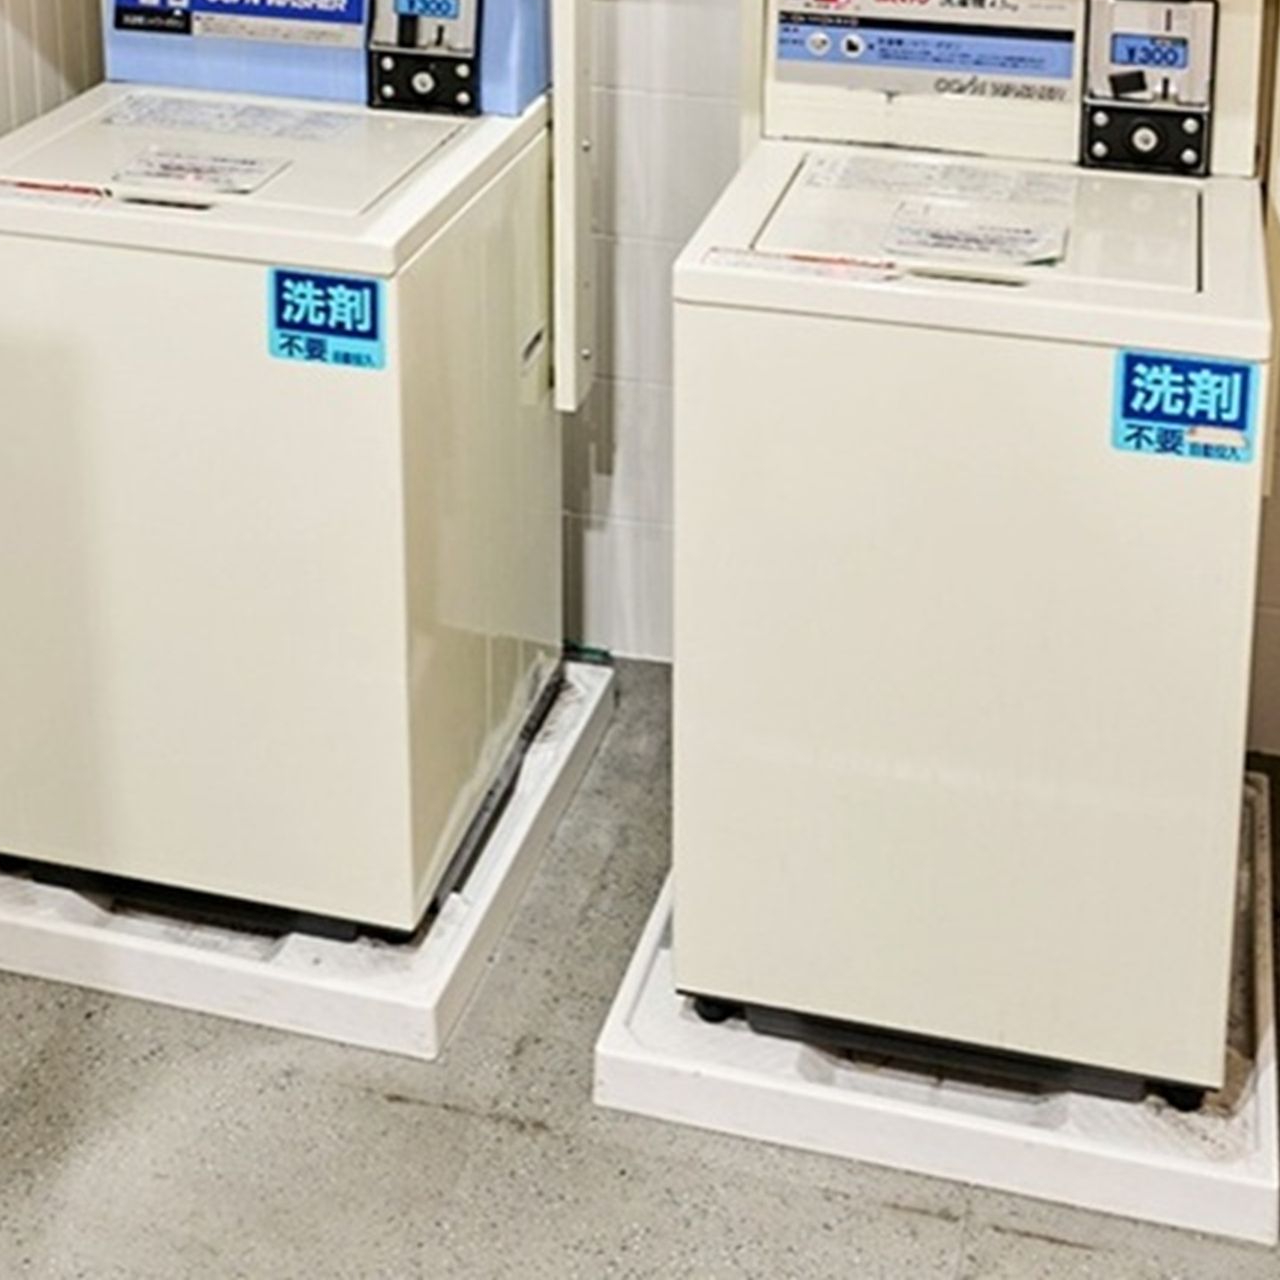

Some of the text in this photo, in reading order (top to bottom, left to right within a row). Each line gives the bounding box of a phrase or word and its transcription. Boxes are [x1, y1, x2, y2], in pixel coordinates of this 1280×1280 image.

[282, 278, 371, 331] 洗剤
[279, 333, 327, 362] 不要
[1130, 363, 1241, 421] 洗剤
[1124, 424, 1184, 455] 不要
